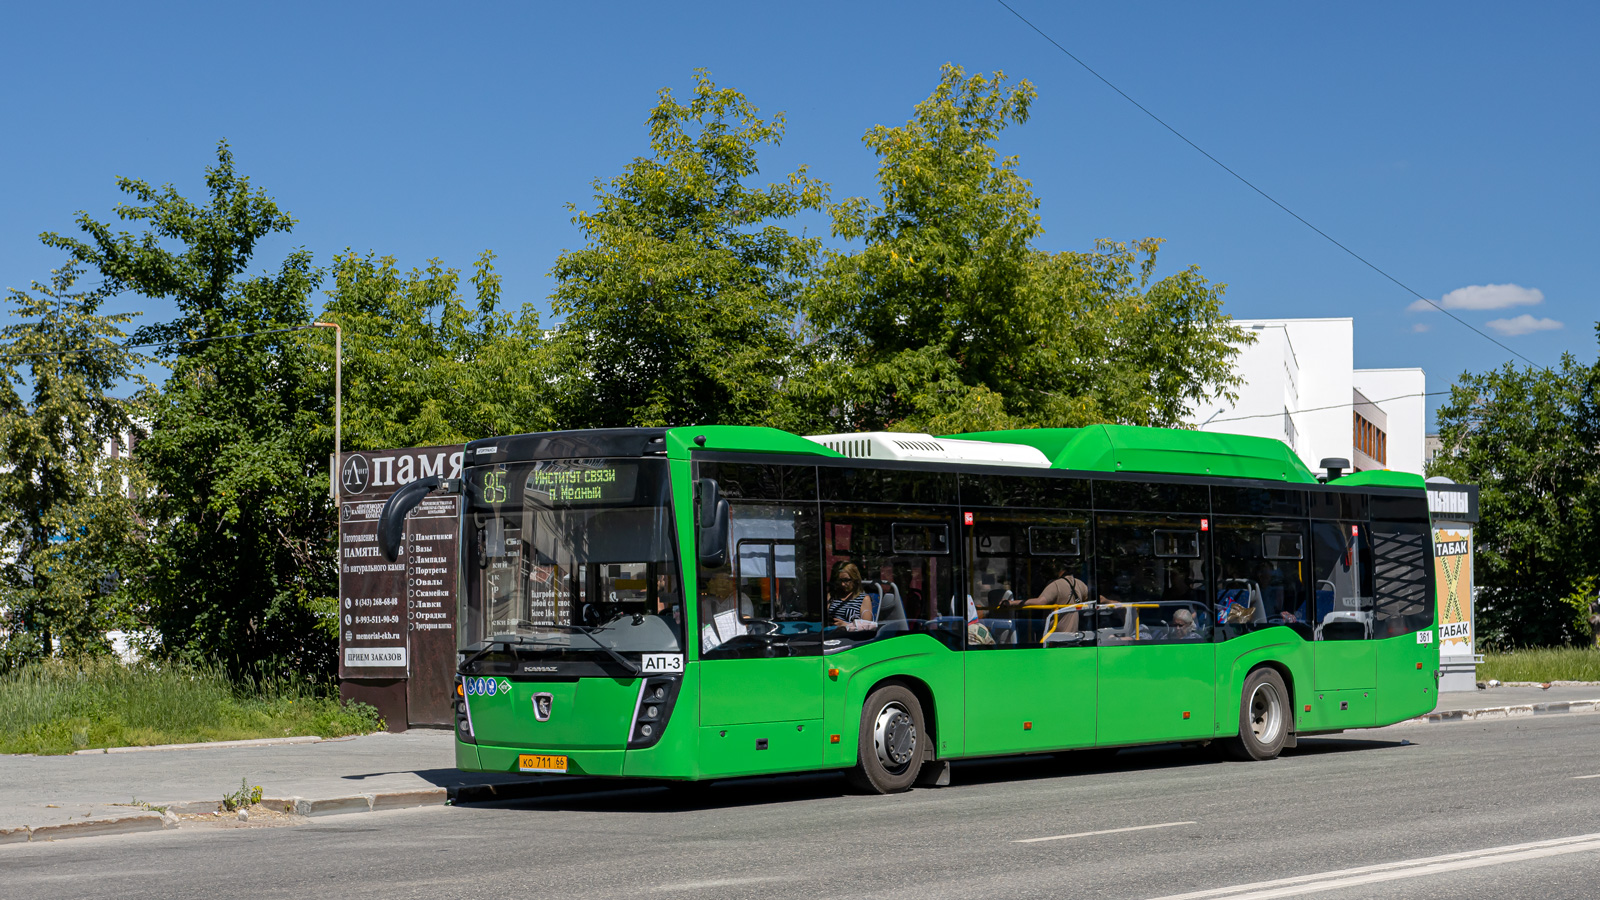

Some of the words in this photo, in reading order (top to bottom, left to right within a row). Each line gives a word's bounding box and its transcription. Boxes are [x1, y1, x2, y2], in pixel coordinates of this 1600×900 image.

[535, 469, 581, 485] Институт
[483, 471, 507, 503] 85
[561, 485, 602, 500] Медный
[415, 533, 453, 541] Памятники
[415, 545, 432, 553] Вазы
[1436, 541, 1467, 556] ТАБАК
[415, 555, 447, 564] Лампады
[342, 564, 350, 573] Из
[350, 564, 387, 575] натурального
[387, 563, 405, 571] камня
[415, 566, 448, 576] Портреты
[415, 578, 443, 586] Овалы
[415, 589, 449, 597] Скамейки
[359, 597, 373, 608] (343)
[415, 600, 442, 608] Лавки
[415, 611, 447, 620] Оградки
[355, 631, 400, 640] memorial-ekb.ru
[1439, 623, 1468, 638] ТАБАК
[1419, 632, 1430, 643] 361
[370, 653, 402, 661] ЗАКАЗОВ
[644, 656, 681, 670] АП-3
[523, 758, 534, 768] КО
[536, 756, 551, 768] 711
[555, 757, 565, 766] 66
